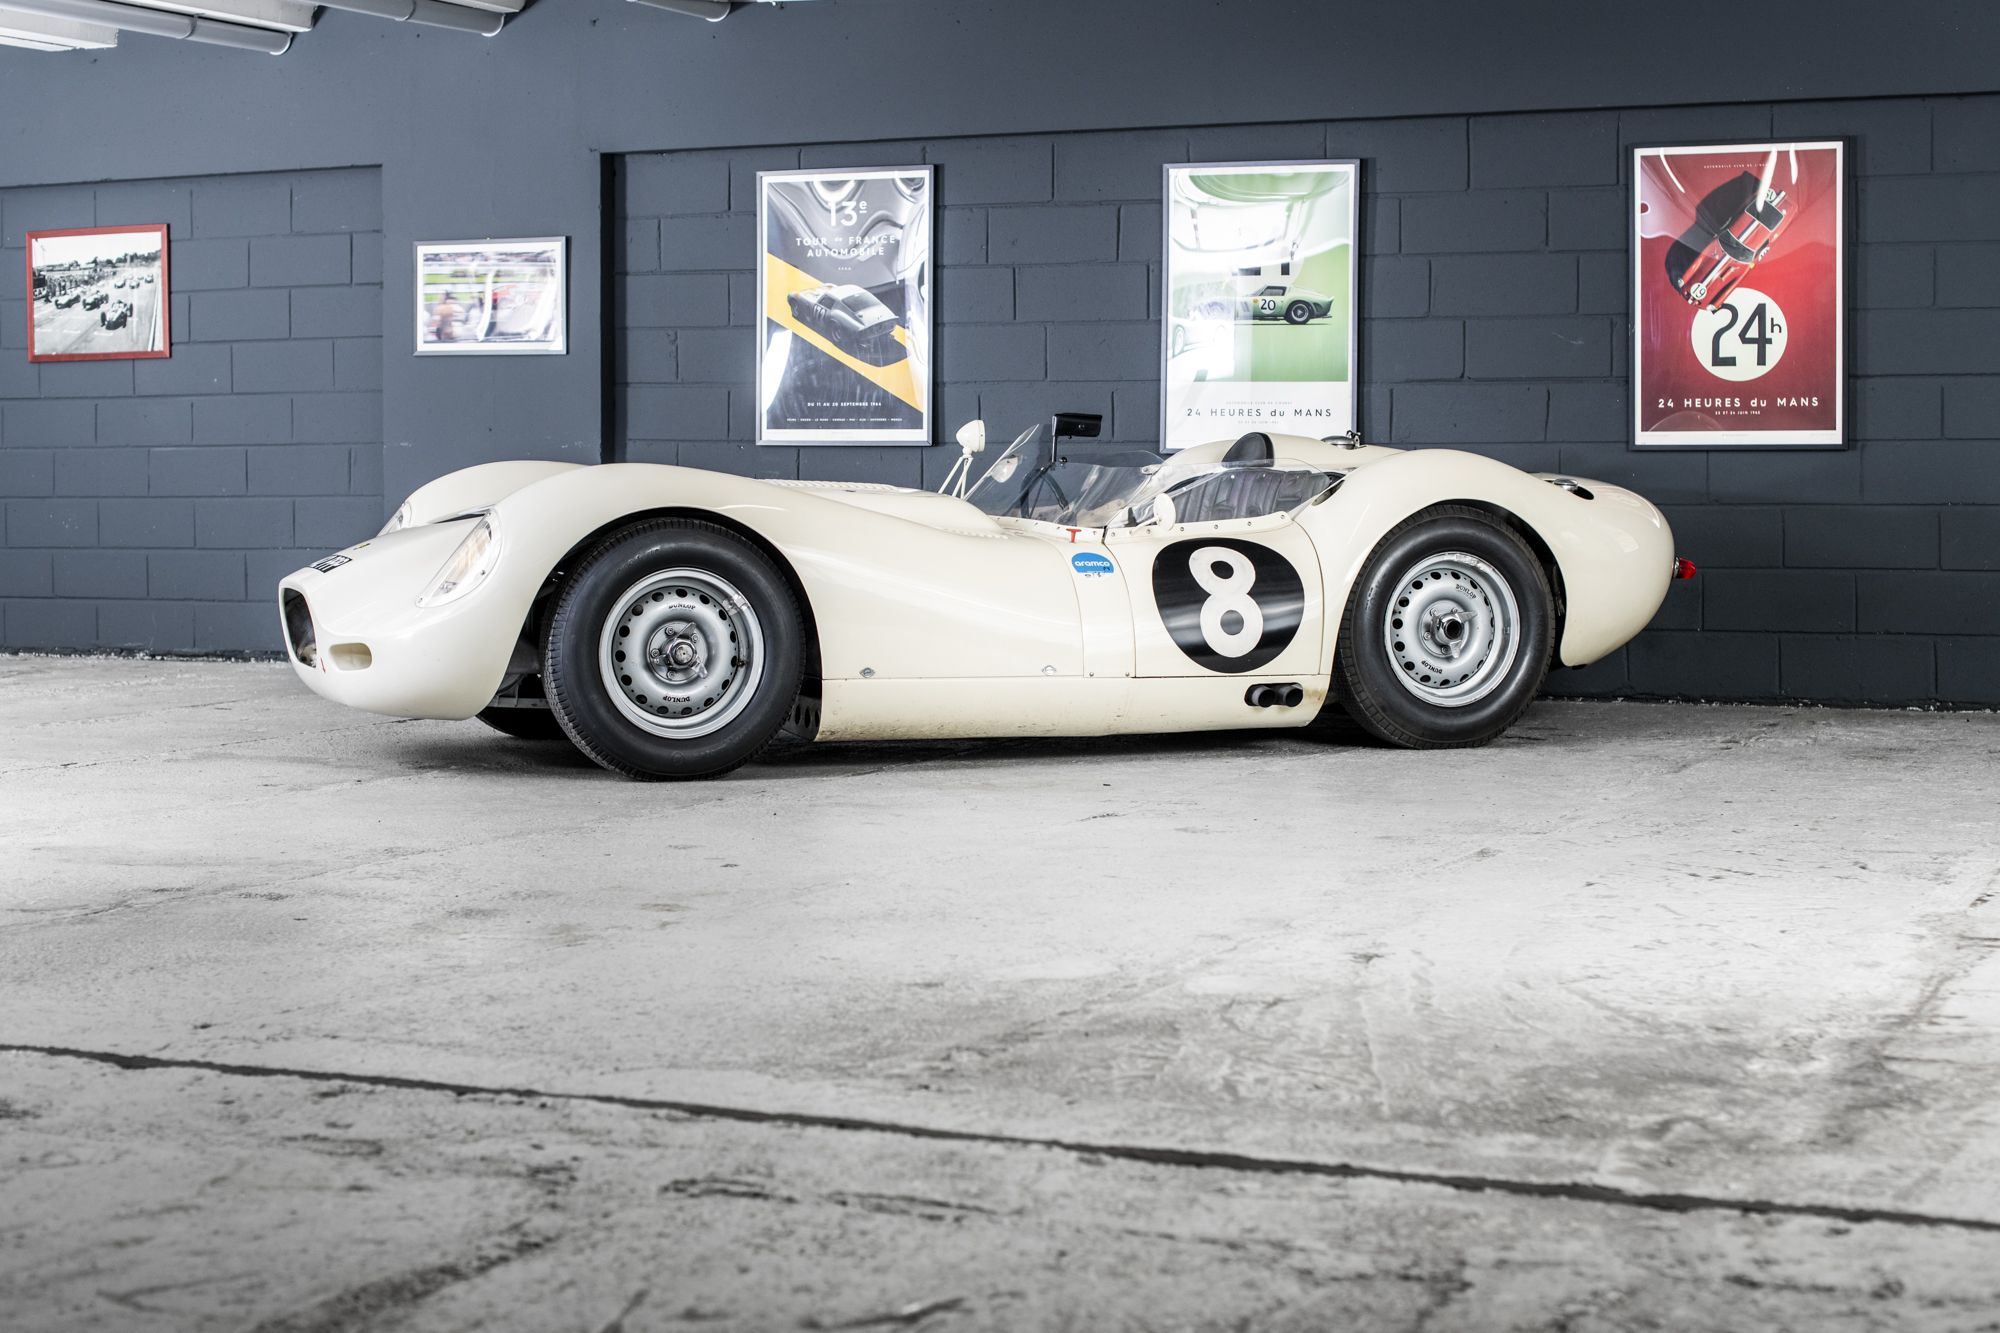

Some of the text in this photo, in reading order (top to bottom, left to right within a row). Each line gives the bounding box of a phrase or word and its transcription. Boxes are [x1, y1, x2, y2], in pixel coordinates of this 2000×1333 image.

[795, 237, 827, 246] TOUR
[848, 235, 896, 245] FRANCE
[807, 247, 884, 257] AUTOMOBILE
[1260, 298, 1276, 311] 20
[1658, 396, 1819, 408] 24 HEURES du MANS
[1187, 408, 1332, 417] 24 HEURES du MANS
[1455, 583, 1477, 599] DUNLOP
[1188, 546, 1264, 658] 8
[1421, 659, 1443, 674] DUNLOP
[663, 695, 691, 703] DUNLOP
